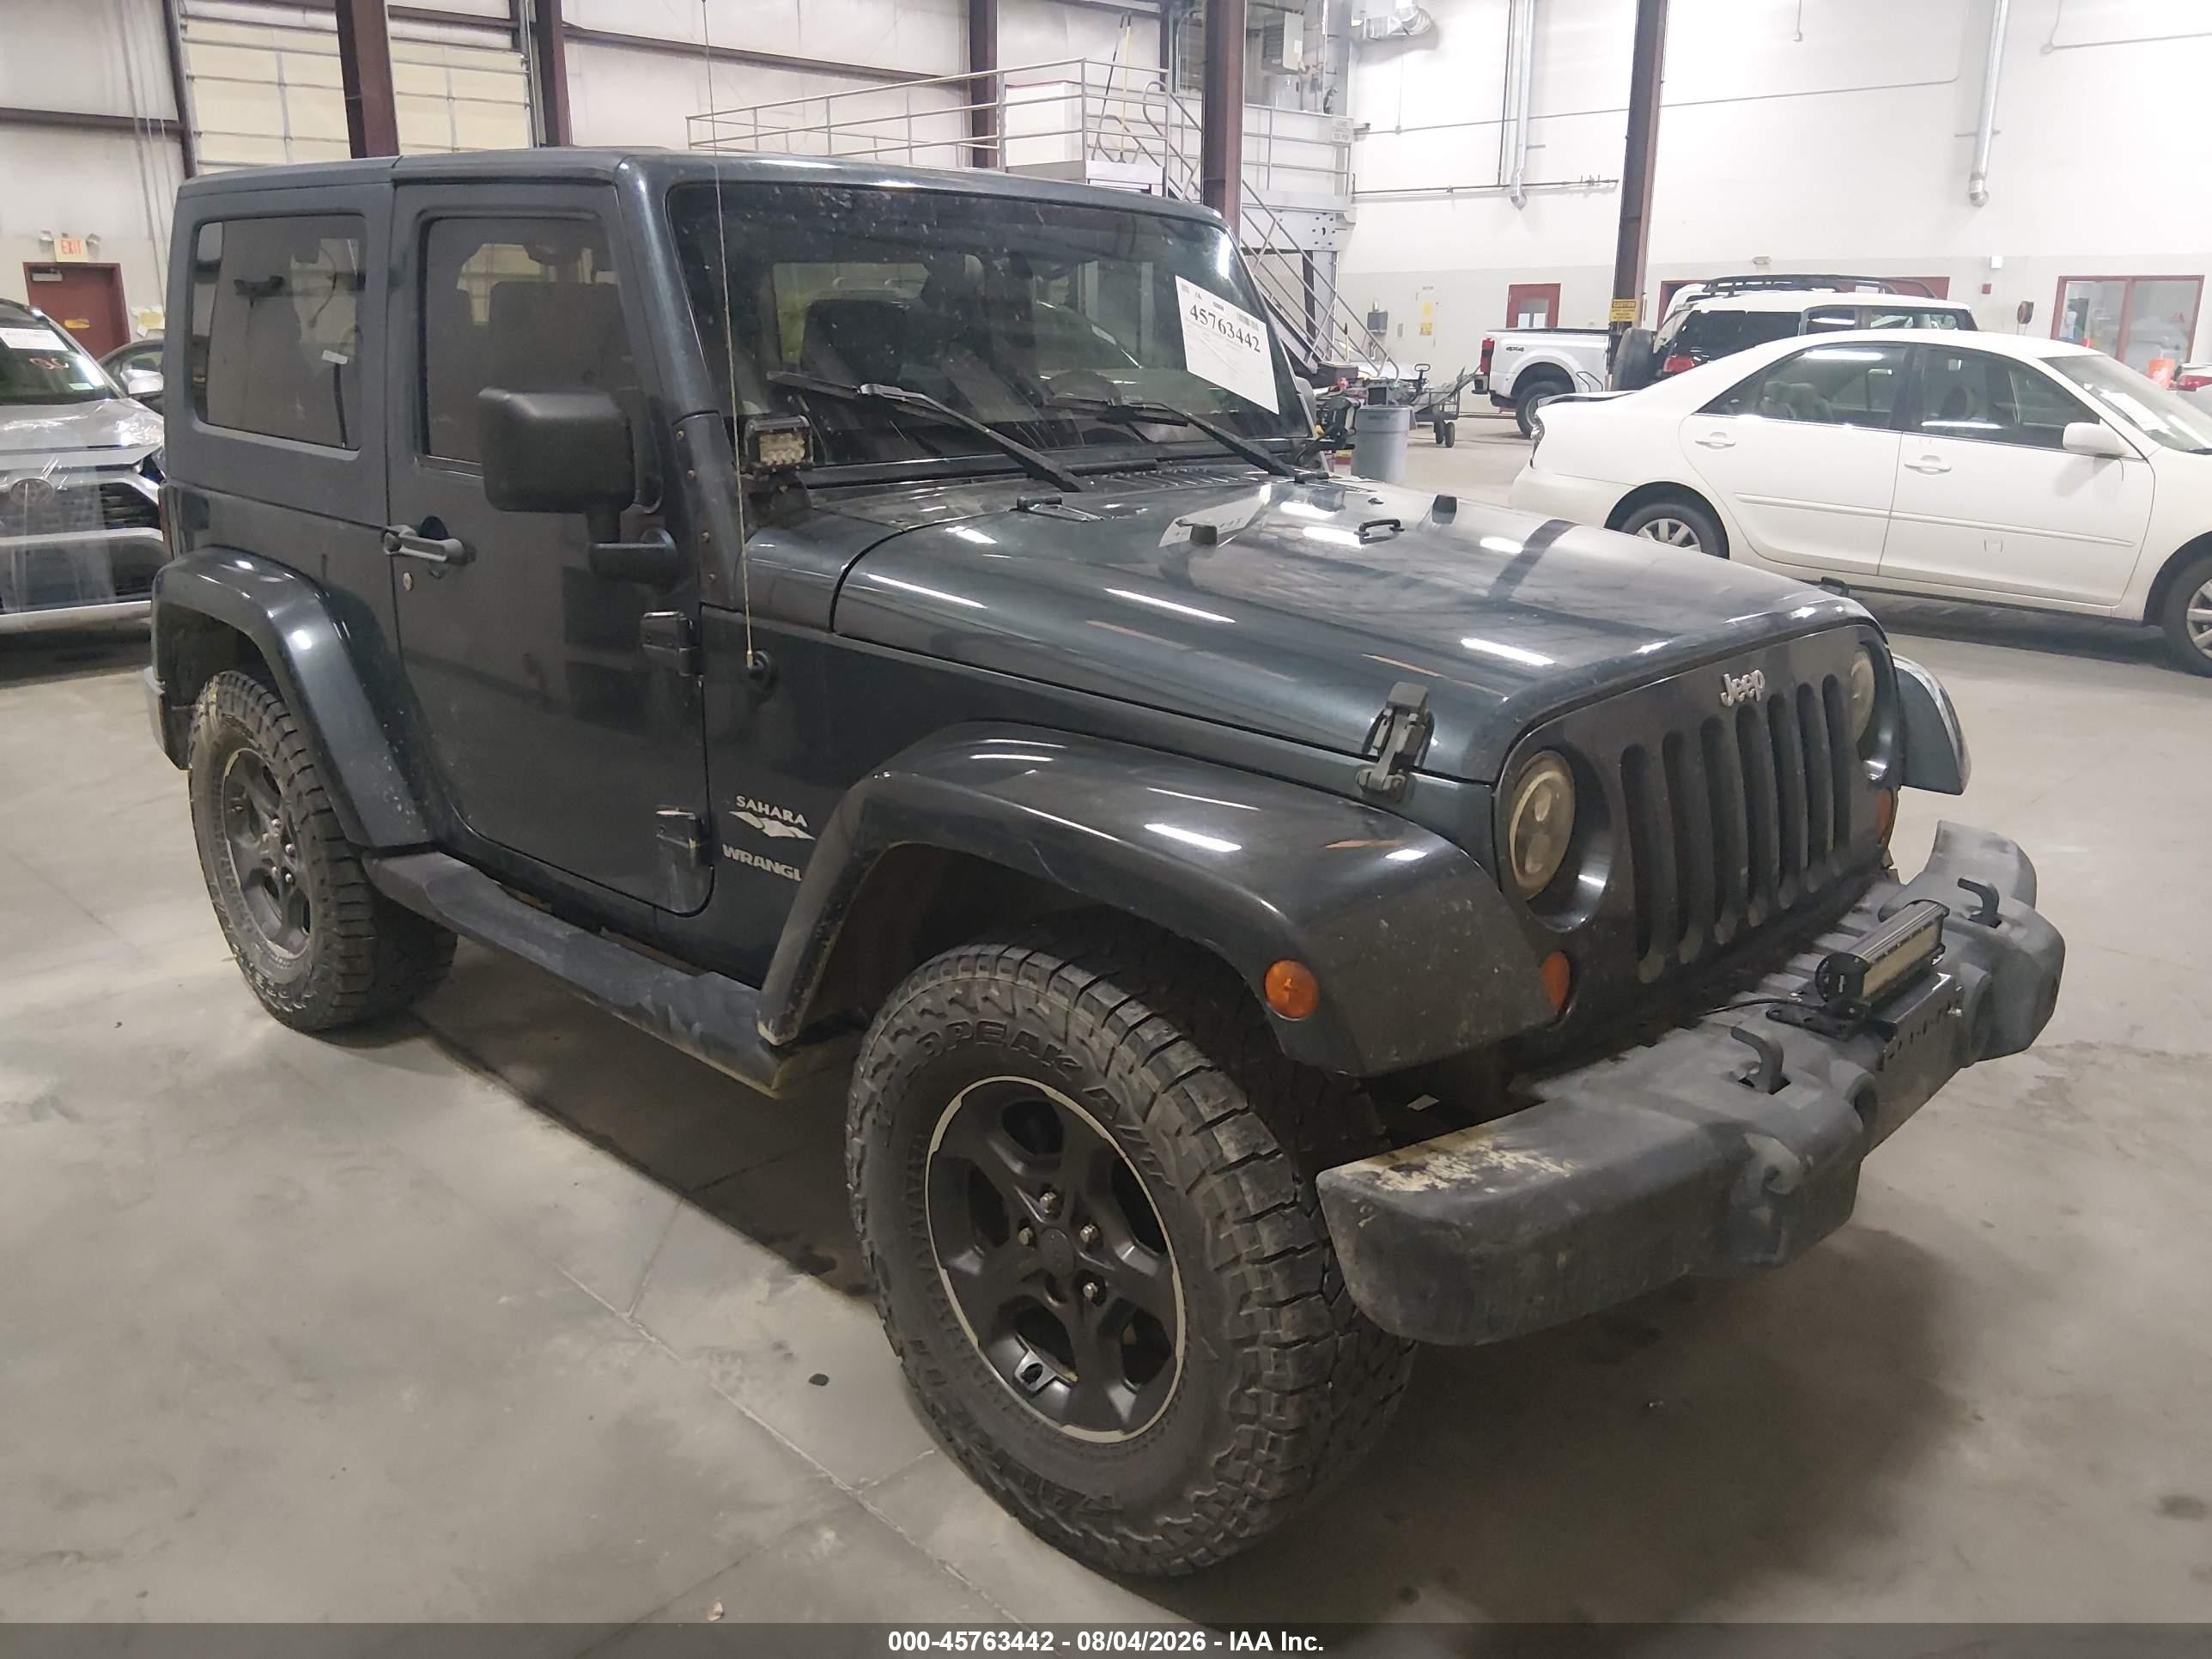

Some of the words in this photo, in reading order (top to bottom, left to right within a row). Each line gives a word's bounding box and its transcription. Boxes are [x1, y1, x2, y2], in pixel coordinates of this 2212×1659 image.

[61, 240, 82, 255] EXIT
[1189, 304, 1261, 353] 45763442
[1720, 669, 1765, 707] Jeep
[735, 795, 808, 828] SAHARA
[722, 843, 803, 882] WRANGL
